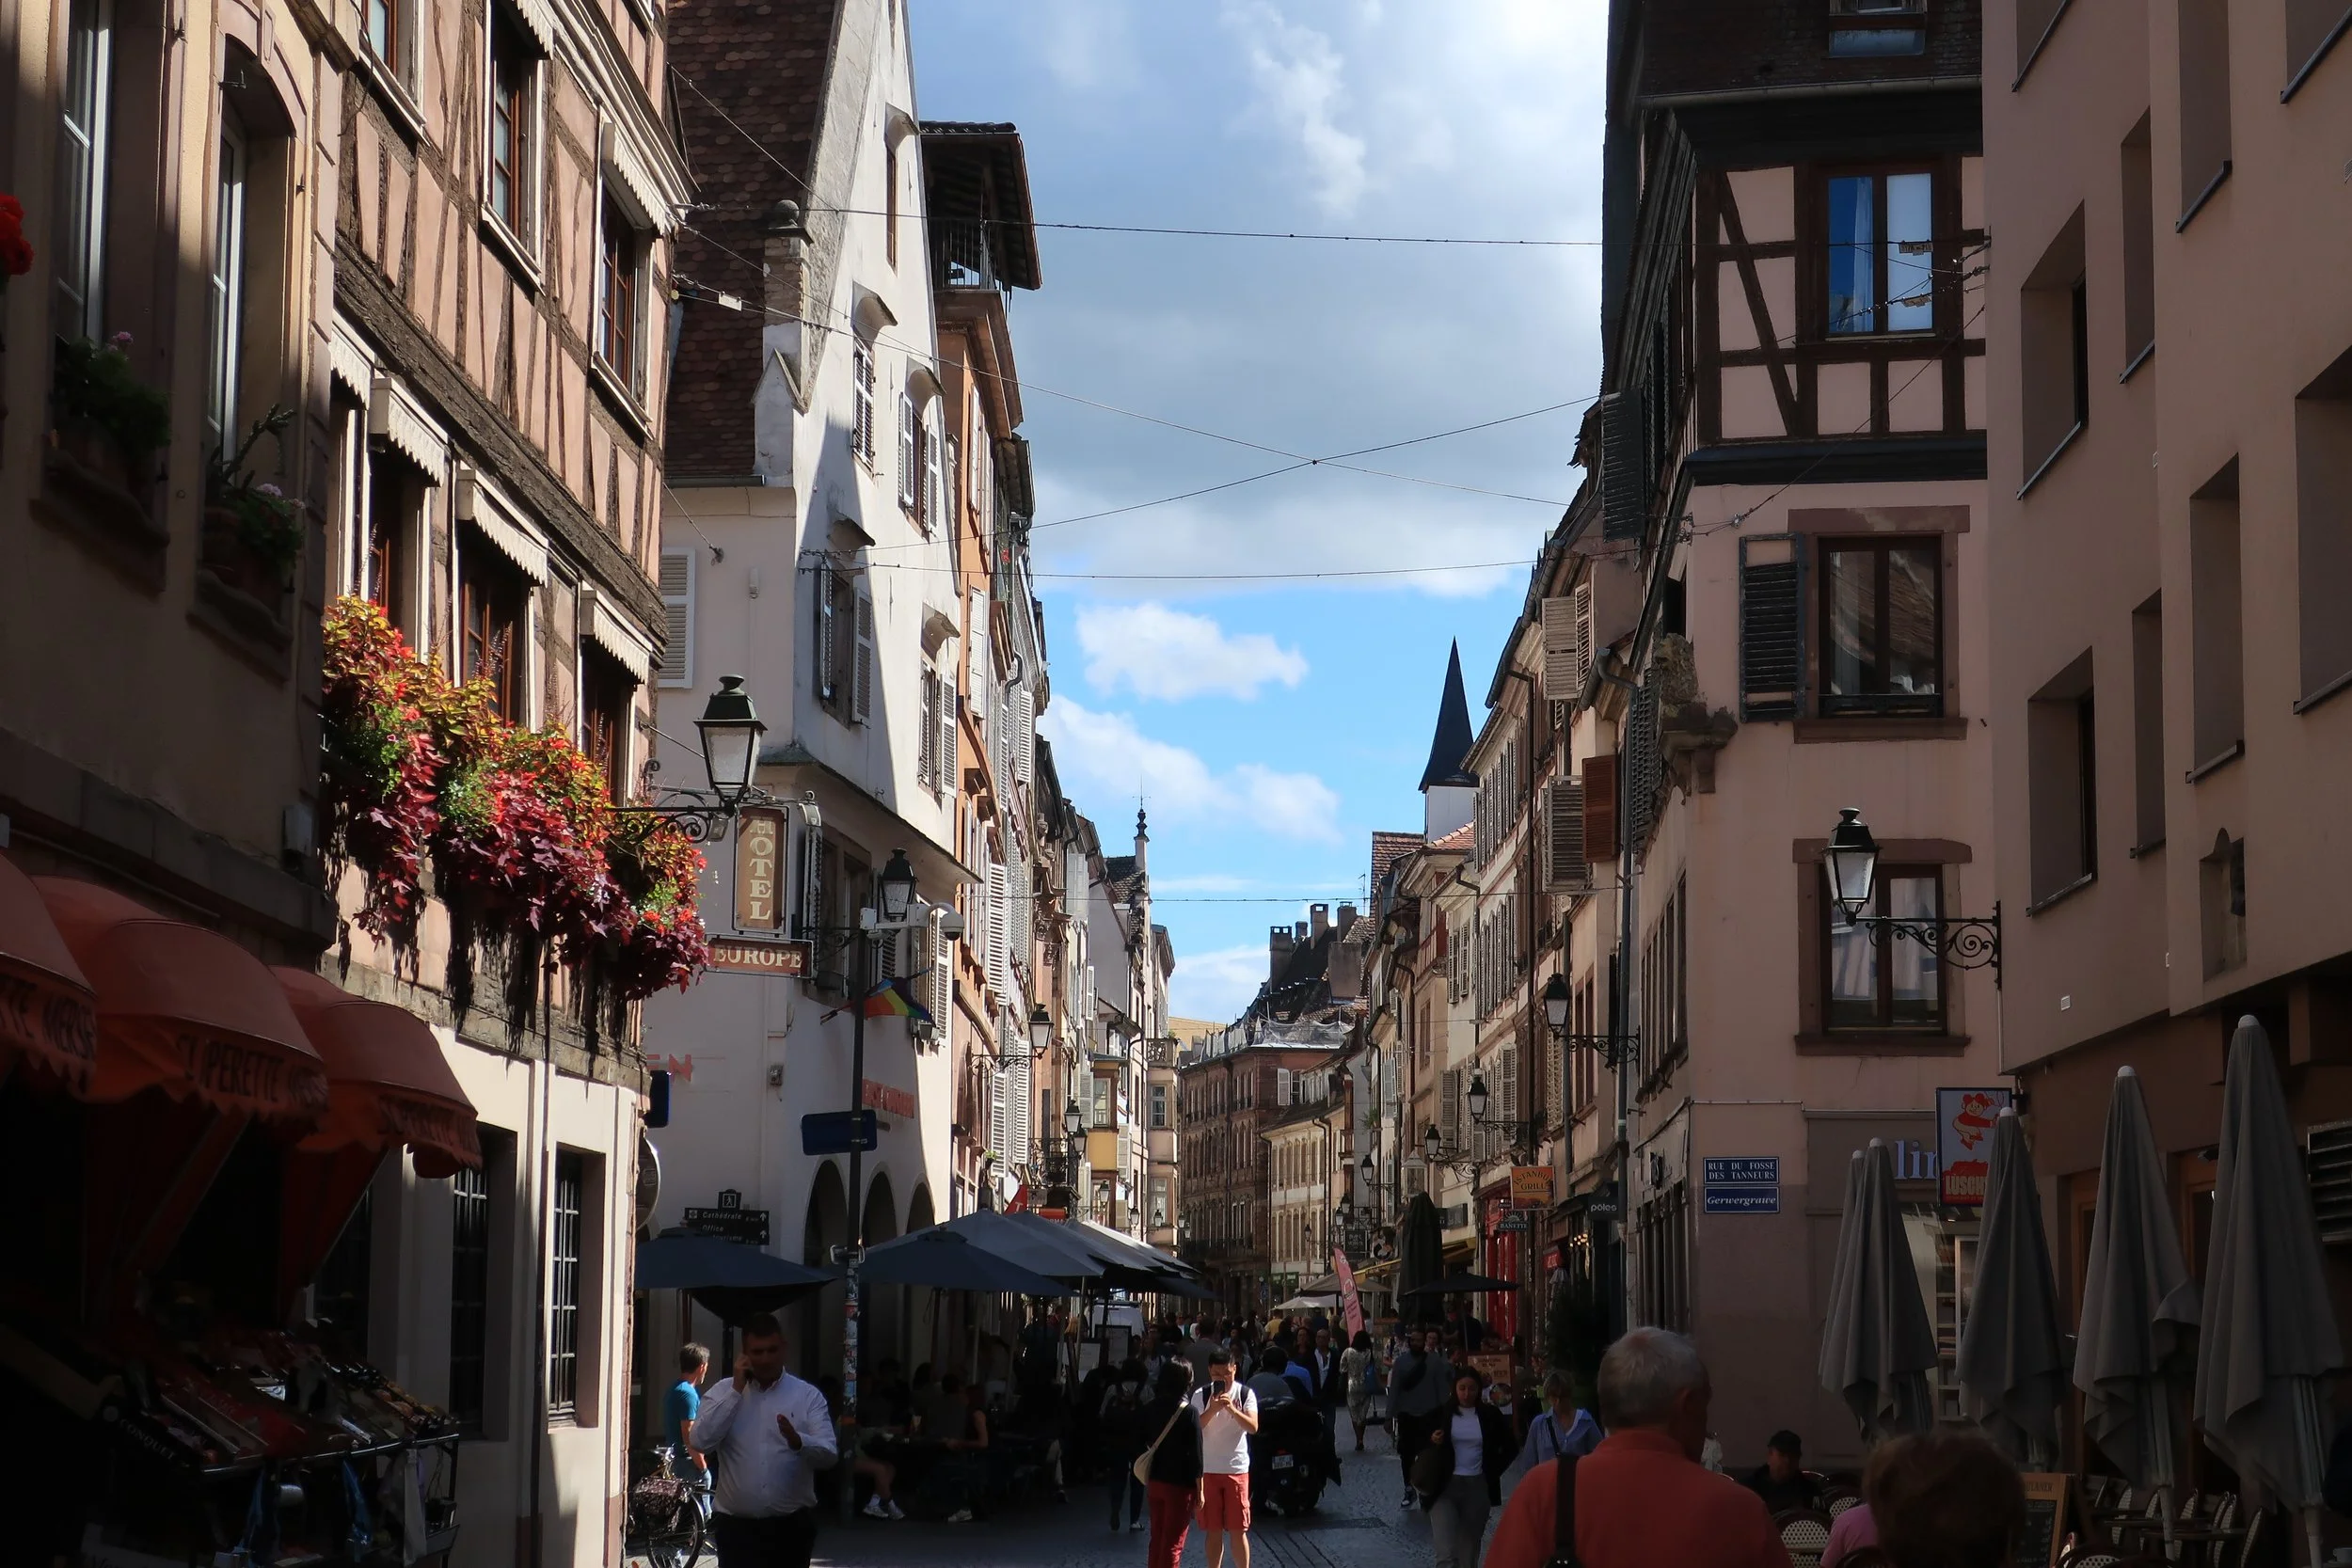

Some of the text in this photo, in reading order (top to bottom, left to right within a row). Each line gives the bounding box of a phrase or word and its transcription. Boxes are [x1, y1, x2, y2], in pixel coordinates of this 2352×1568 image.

[749, 816, 773, 921] HOTEL
[713, 944, 803, 969] EUROPE
[1708, 1162, 1724, 1170] RUE
[1731, 1162, 1743, 1170] DU
[1731, 1171, 1775, 1180] TANNEURS
[1945, 1175, 1987, 1196] LUSCH
